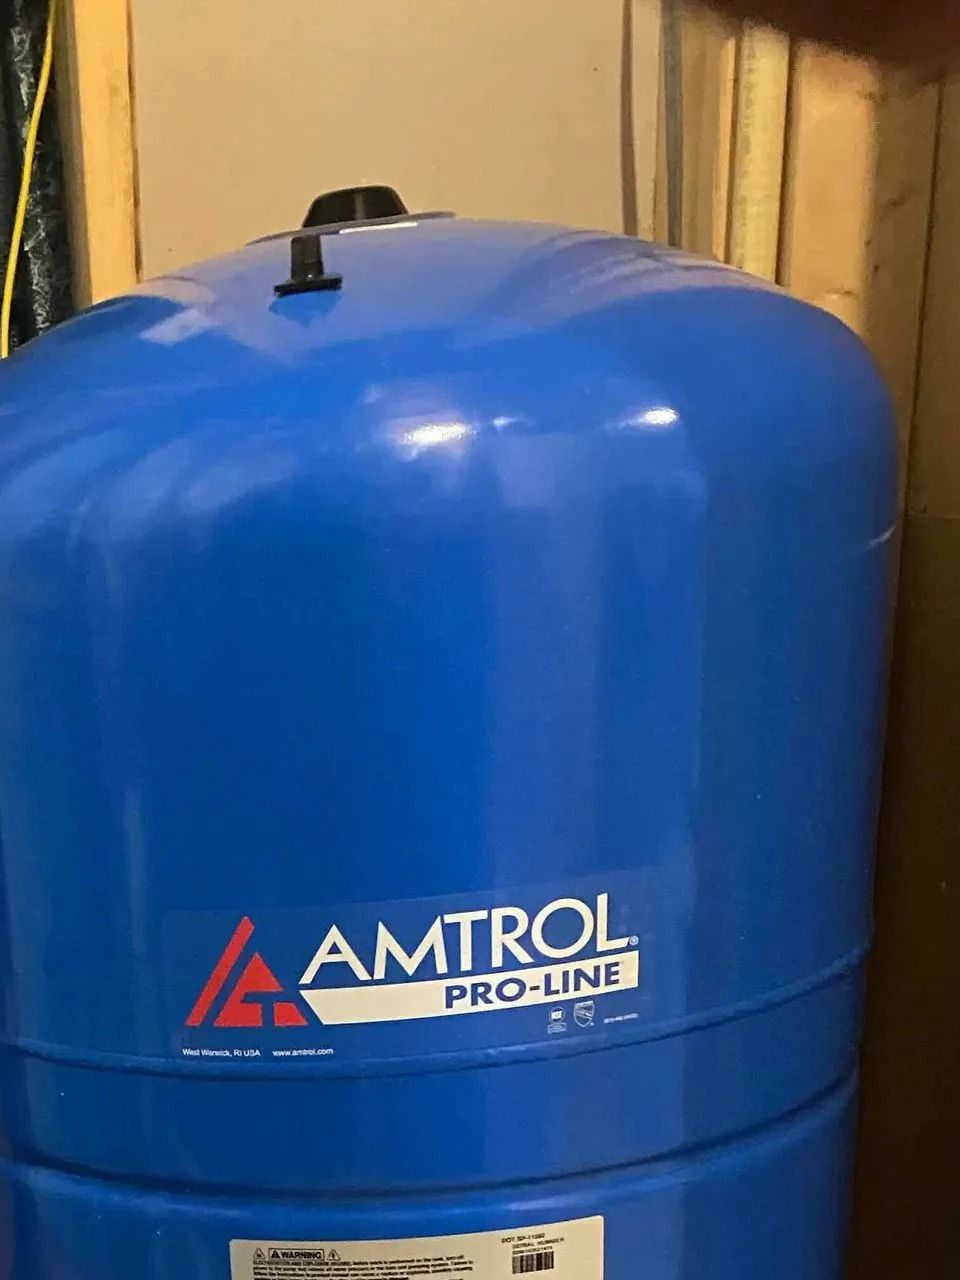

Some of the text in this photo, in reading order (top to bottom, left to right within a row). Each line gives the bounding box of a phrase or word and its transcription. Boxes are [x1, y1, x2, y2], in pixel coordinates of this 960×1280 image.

[299, 893, 630, 984] AMTROL
[445, 961, 620, 1009] PRO-LINE
[182, 1048, 200, 1056] West
[243, 1049, 261, 1057] USA
[272, 1048, 334, 1057] www.amtrol.com
[280, 1251, 322, 1259] WARNING
